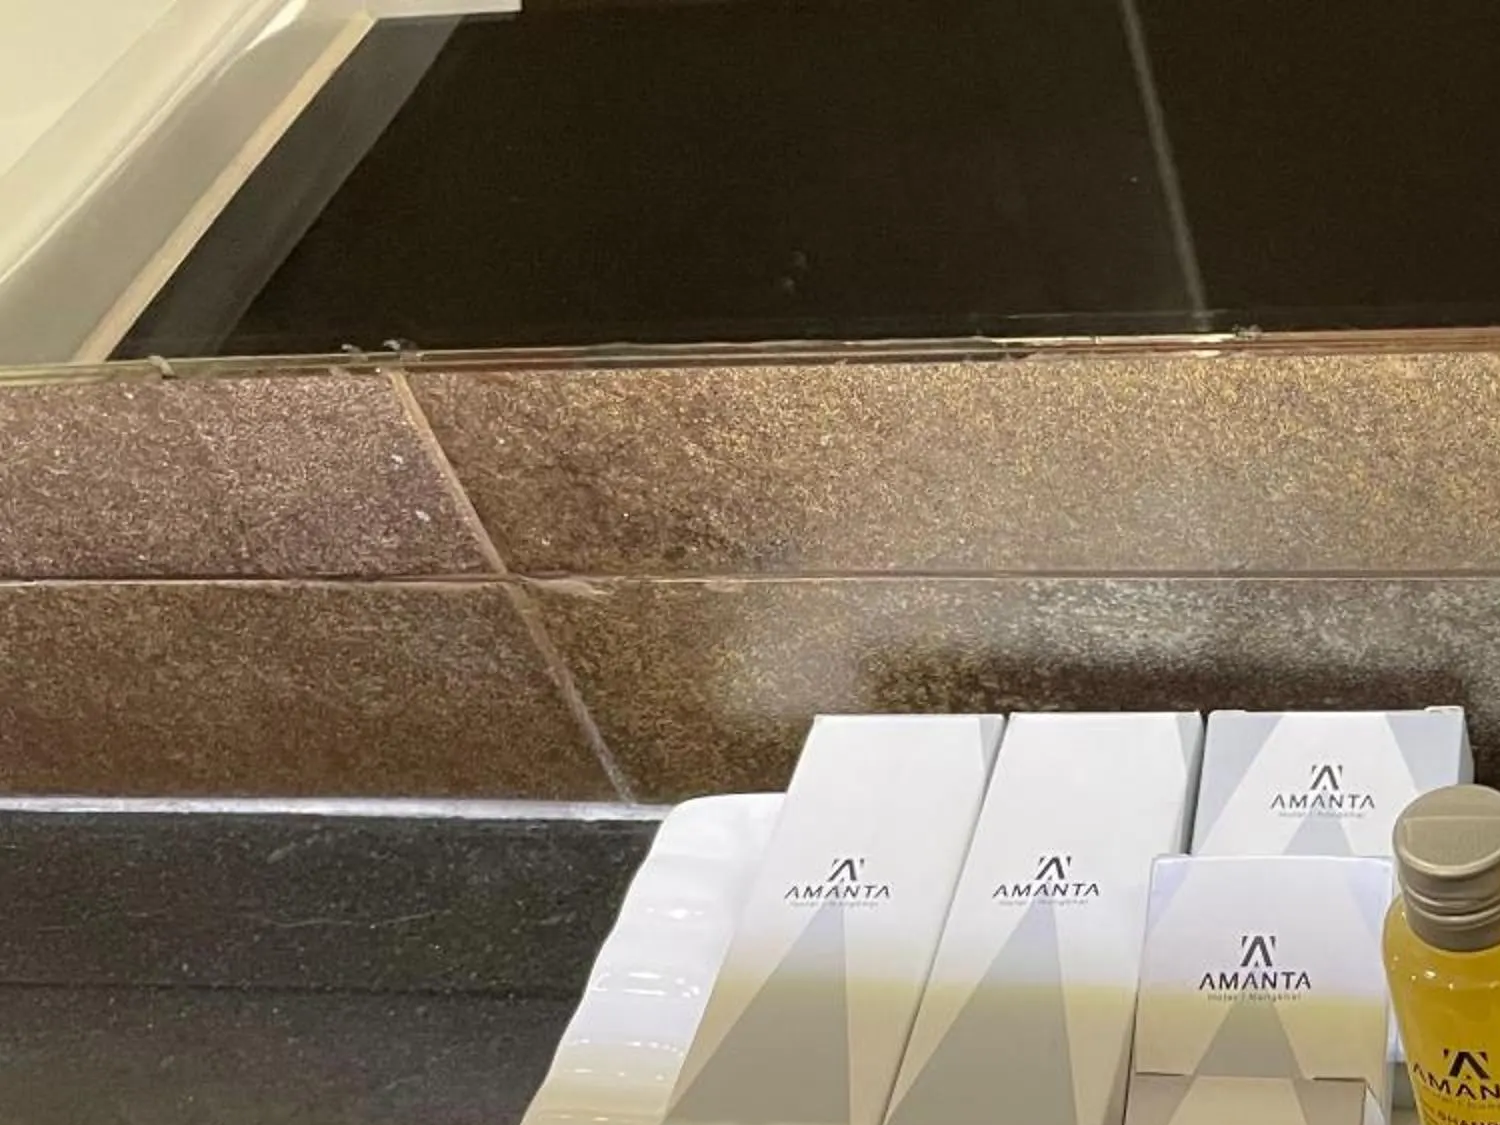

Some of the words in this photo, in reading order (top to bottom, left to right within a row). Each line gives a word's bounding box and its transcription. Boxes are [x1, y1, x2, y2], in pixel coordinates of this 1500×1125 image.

[1270, 793, 1376, 809] AMANTA
[784, 884, 892, 899] AMANTA
[992, 882, 1101, 898] AMANTA
[1198, 971, 1312, 990] AMANTA
